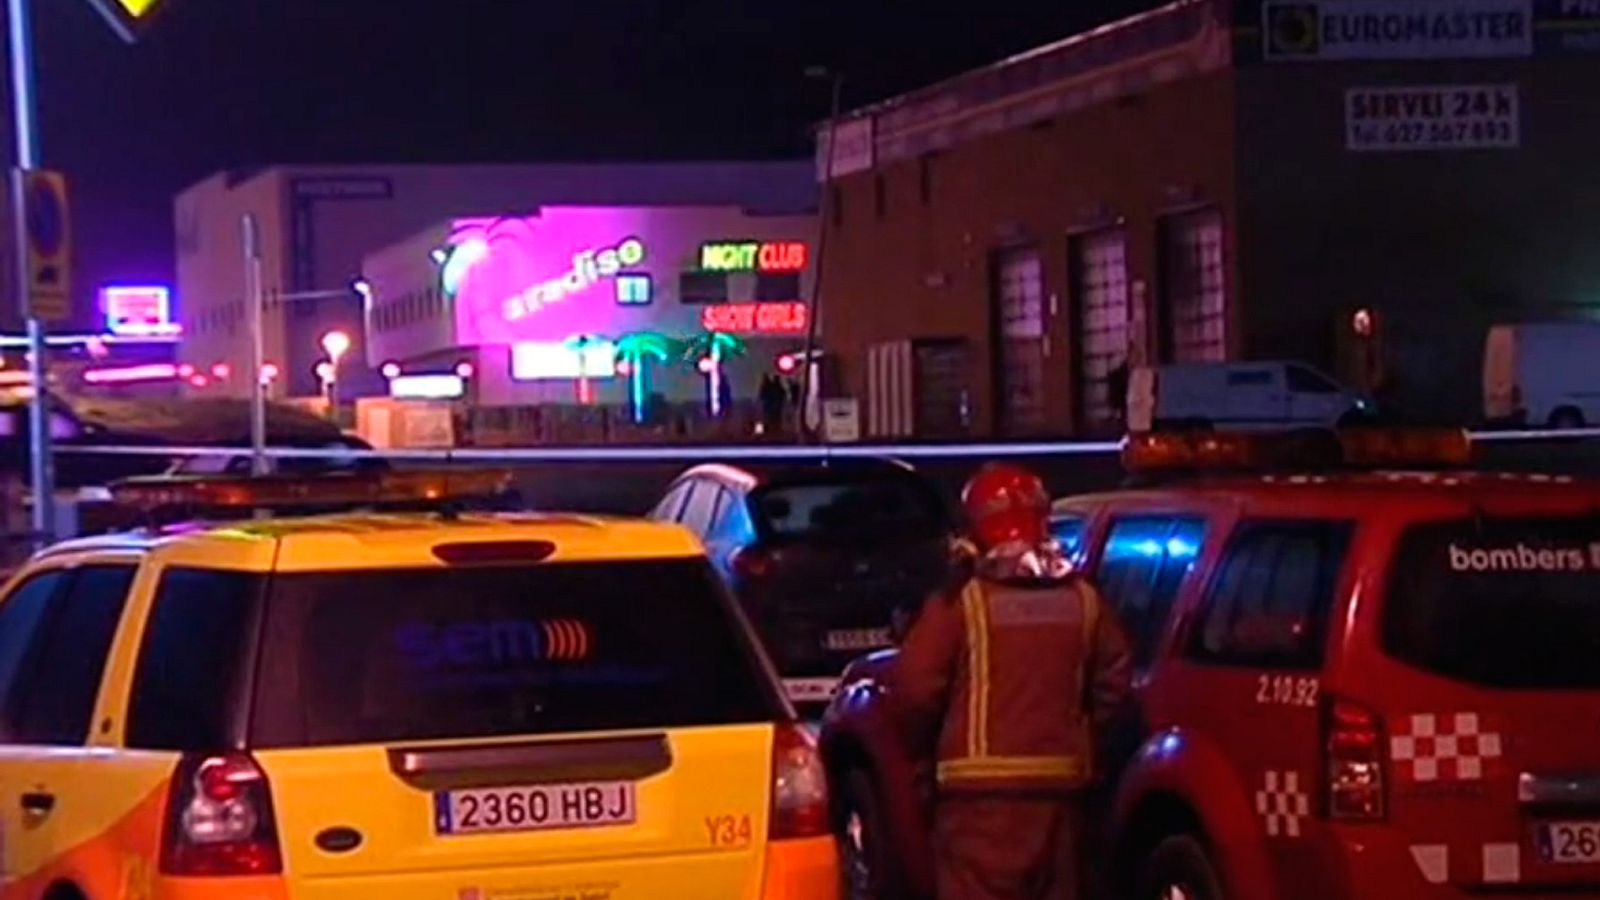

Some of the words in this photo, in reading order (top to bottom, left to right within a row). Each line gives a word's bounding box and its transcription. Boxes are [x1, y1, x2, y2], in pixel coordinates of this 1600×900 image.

[1323, 13, 1523, 44] EUROMASTER
[1453, 90, 1489, 116] 24
[701, 243, 758, 270] NIGHT
[758, 242, 807, 270] CLUB
[702, 304, 755, 331] SHOW
[756, 302, 807, 330] GIRLS
[1449, 541, 1585, 572] bombers
[395, 619, 541, 668] sem
[1256, 676, 1320, 706] 2.10.92
[459, 789, 550, 827] 2360
[561, 786, 628, 822] HBJ
[705, 816, 753, 845] Y34
[1558, 826, 1600, 858] 26
